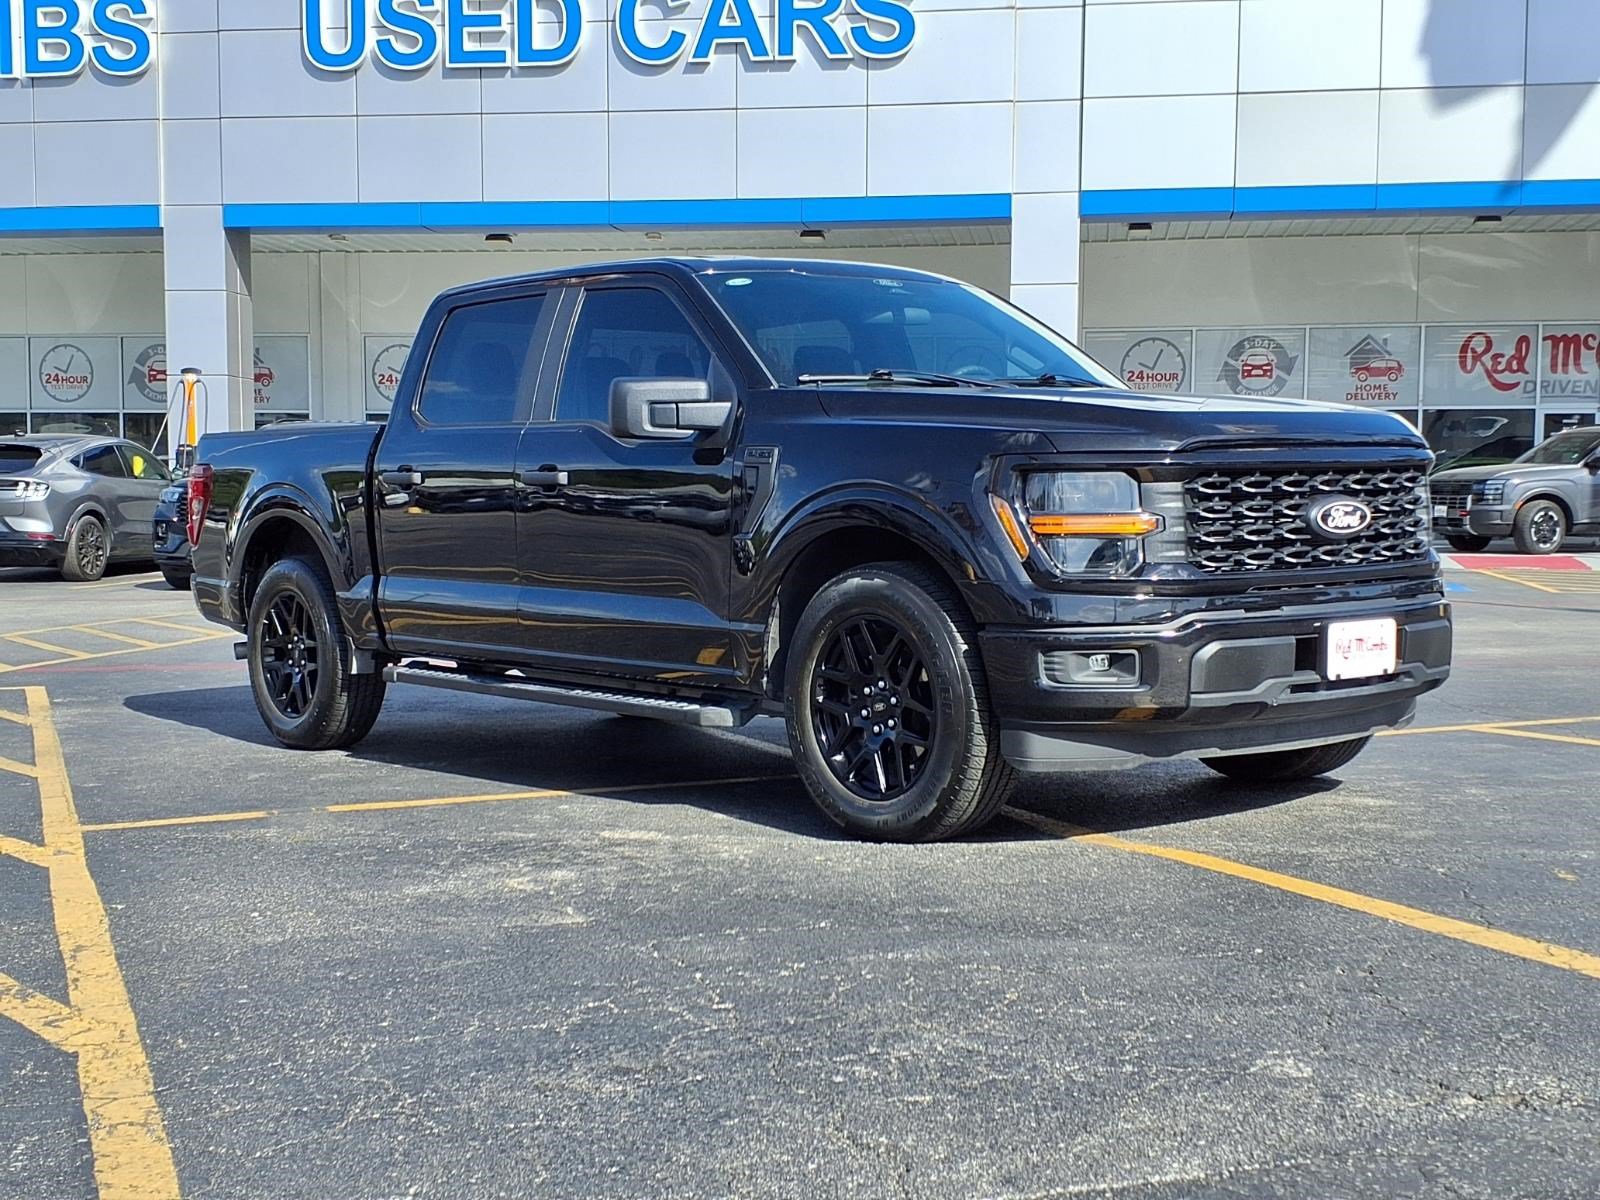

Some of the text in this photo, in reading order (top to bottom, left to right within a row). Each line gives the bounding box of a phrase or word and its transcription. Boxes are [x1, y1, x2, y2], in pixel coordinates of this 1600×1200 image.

[300, 0, 918, 71] USED CARS
[1458, 332, 1600, 392] Red Mc
[1345, 391, 1399, 401] DELIVERY
[1354, 383, 1390, 392] HOME
[1327, 506, 1361, 528] Ford
